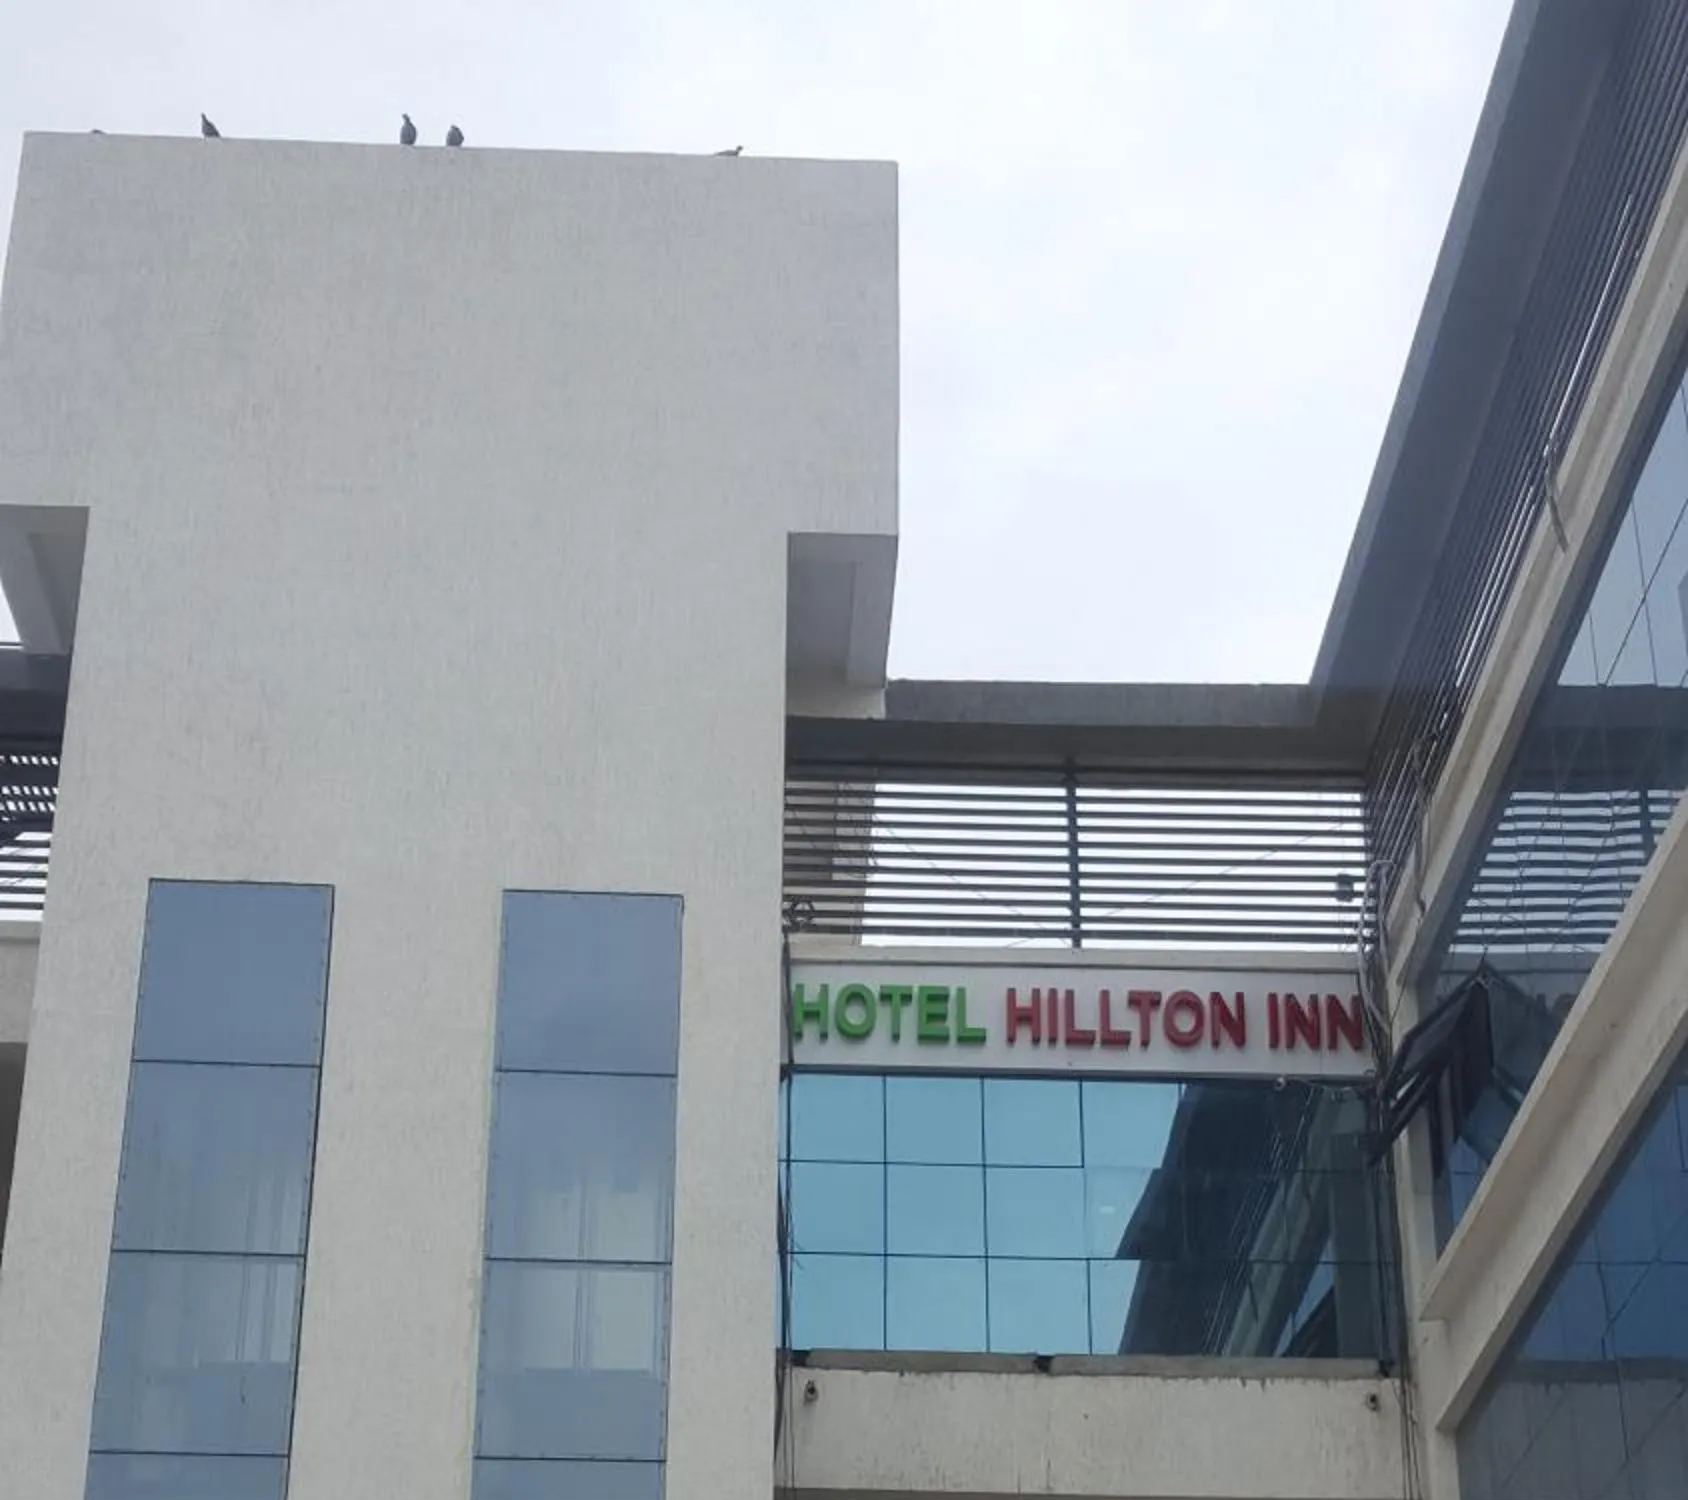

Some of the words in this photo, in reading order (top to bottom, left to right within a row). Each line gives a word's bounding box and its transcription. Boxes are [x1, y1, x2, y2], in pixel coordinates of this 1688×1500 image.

[793, 983, 987, 1046] HOTEL
[1005, 987, 1247, 1049] HILLTON
[1267, 991, 1364, 1052] INN
